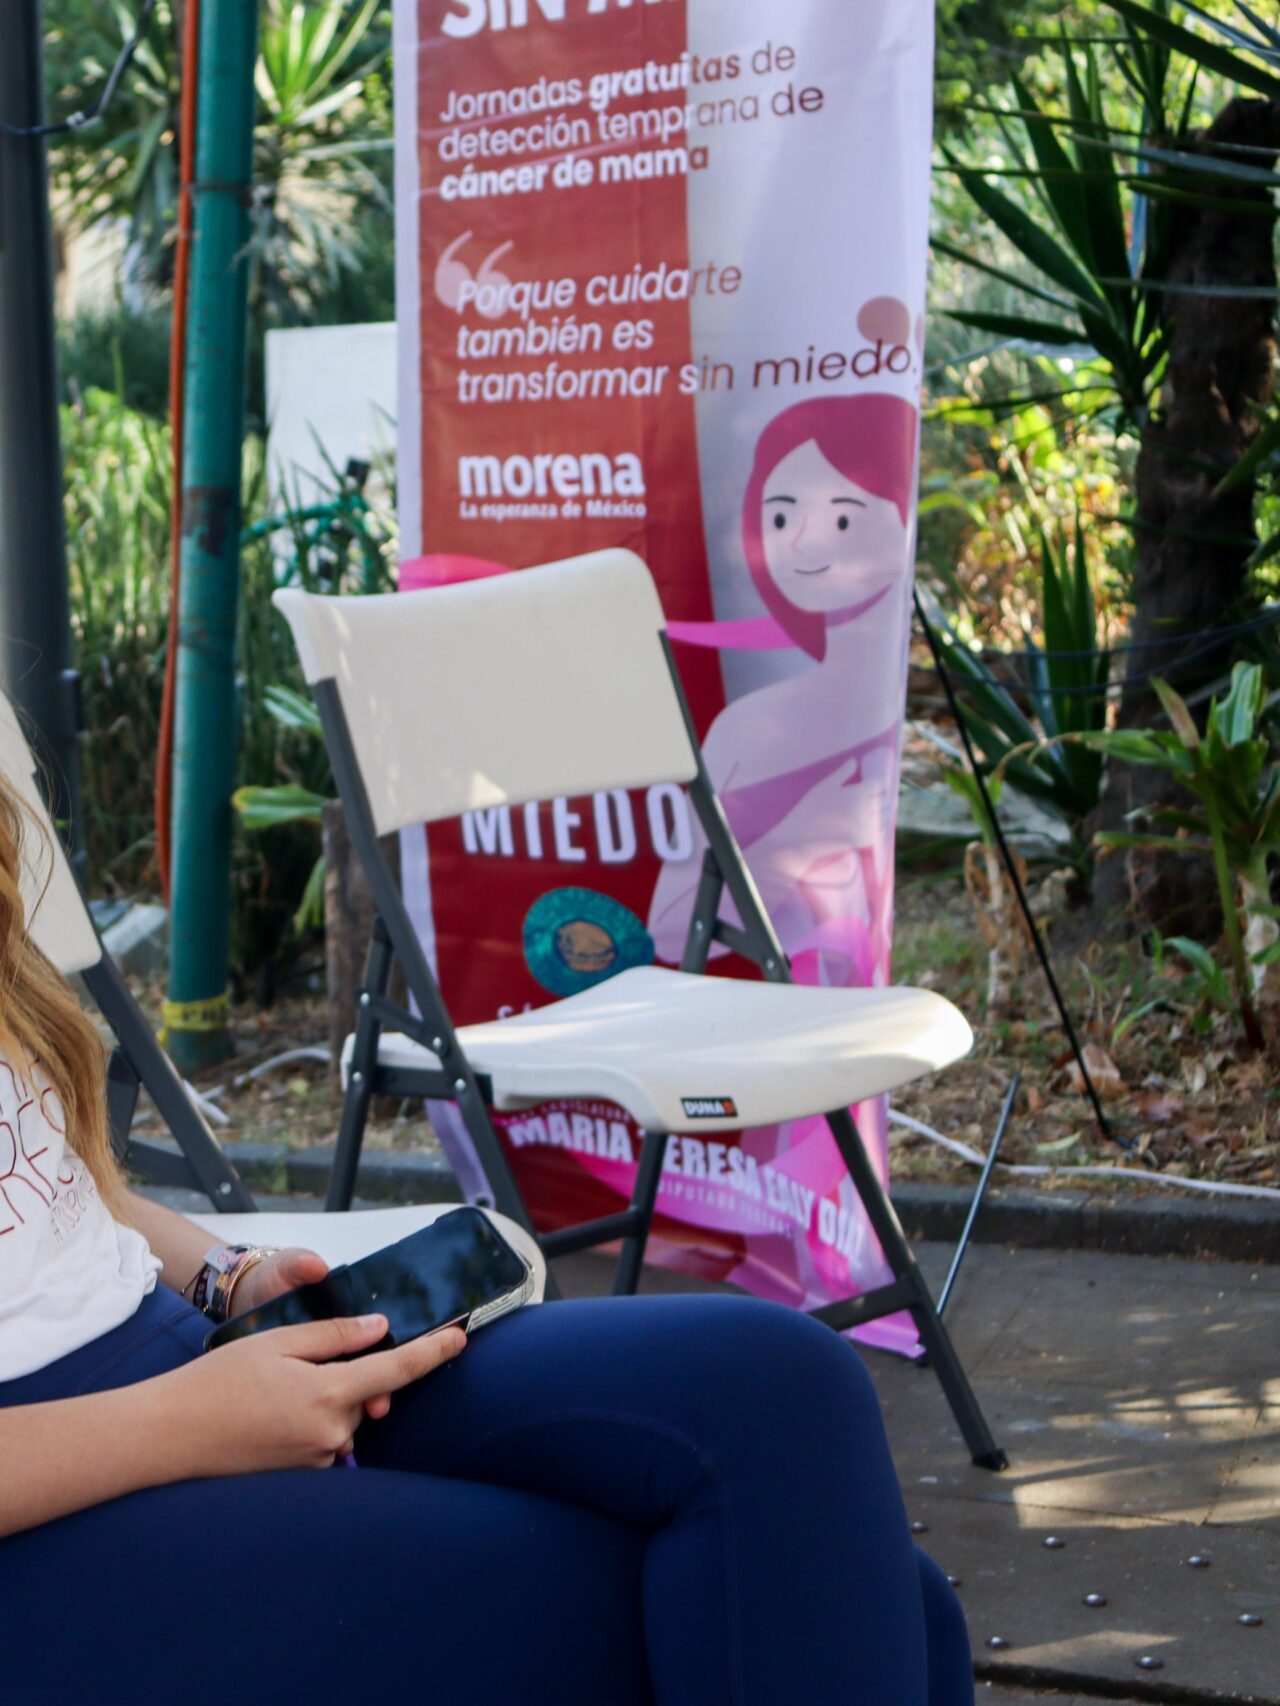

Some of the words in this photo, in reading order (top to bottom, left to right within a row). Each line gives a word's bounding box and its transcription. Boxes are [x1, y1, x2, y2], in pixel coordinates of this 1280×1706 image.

[440, 76, 583, 122] Jornadas
[589, 51, 740, 111] gratuitas
[751, 40, 795, 75] de
[438, 113, 591, 162] detección
[598, 95, 759, 144] temprana
[771, 82, 824, 117] de
[439, 163, 549, 201] cáncer
[552, 153, 594, 188] de
[599, 145, 709, 183] mama
[456, 278, 576, 321] Porque
[585, 261, 742, 306] cuidarte
[457, 314, 602, 358] también
[612, 318, 654, 350] es
[457, 361, 669, 403] transformar
[679, 356, 735, 395] sin
[458, 452, 646, 498] morena
[459, 500, 478, 519] La
[480, 502, 559, 523] esperanza
[561, 499, 582, 519] de
[584, 499, 647, 519] México
[461, 783, 695, 861] MIEDO
[637, 1128, 762, 1201] ERESA
